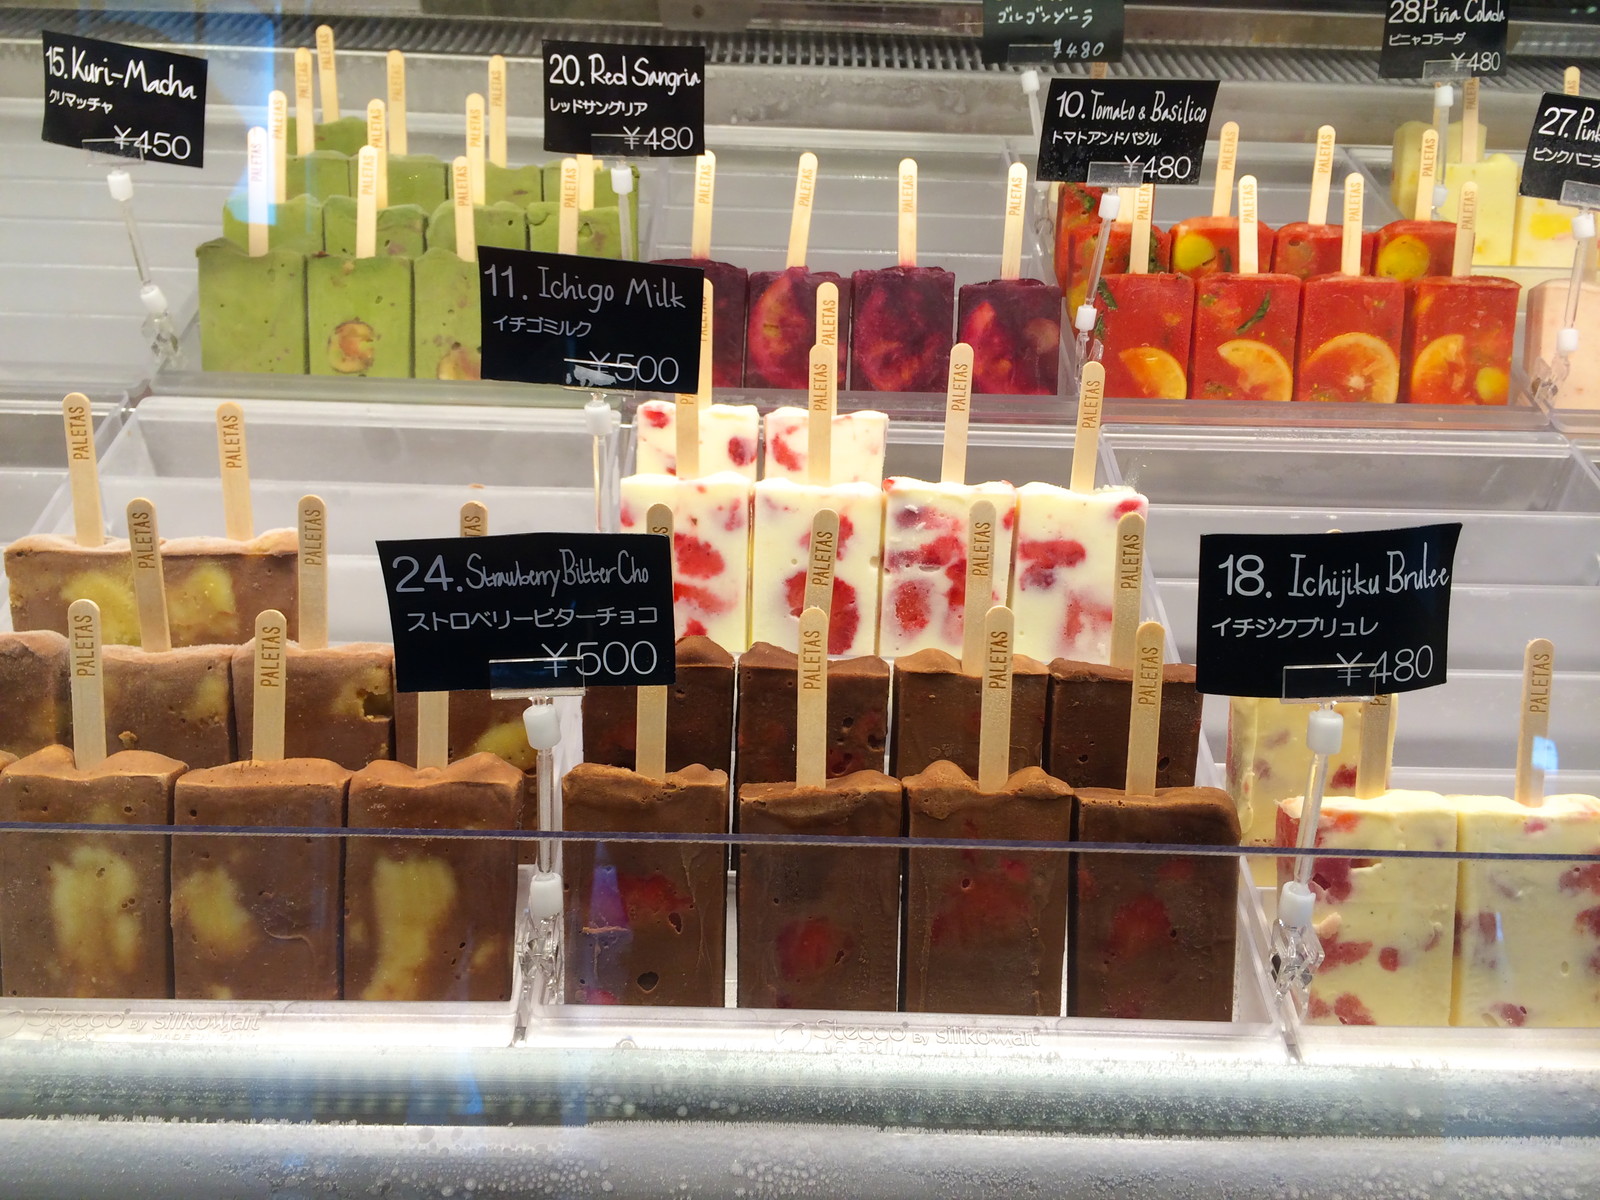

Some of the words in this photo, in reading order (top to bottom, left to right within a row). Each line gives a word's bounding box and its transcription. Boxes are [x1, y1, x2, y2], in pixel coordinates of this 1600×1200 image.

[1423, 0, 1461, 24] Piña
[1464, 0, 1505, 23] Colada
[1053, 38, 1105, 59] ¥480
[1388, 31, 1467, 46] ピニャコラーダ
[588, 53, 628, 87] Red
[631, 55, 701, 95] Sangria
[1450, 51, 1501, 72] ¥480
[49, 90, 113, 116] クリマッチャ
[549, 98, 648, 117] レッドサングリア
[1090, 88, 1136, 121] Tomato
[1149, 90, 1207, 124] Basilico
[113, 125, 191, 161] ¥450
[469, 108, 481, 148] PALETAS
[623, 126, 694, 151] ¥480
[1052, 130, 1162, 147] トマトアンドバジル
[251, 141, 265, 183] PALETAS
[1124, 154, 1192, 179] ¥480
[1221, 131, 1236, 172] PALETAS
[1317, 133, 1332, 174] PALETAS
[1421, 137, 1436, 177] PALETAS
[362, 154, 375, 196] PALETAS
[455, 165, 470, 207] PALETAS
[564, 167, 577, 209] PALETAS
[697, 163, 713, 205] PALETAS
[798, 168, 814, 208] PALETAS
[901, 174, 914, 214] PALETAS
[1008, 176, 1023, 217] PALETAS
[1136, 183, 1151, 221] PALETA
[1243, 183, 1255, 225] PALETAS
[1349, 181, 1362, 222] PALETAS
[1461, 189, 1475, 231] PALETAS
[536, 265, 615, 314] Ichigo
[625, 277, 687, 310] Milk
[492, 314, 593, 338] イチゴミルク
[822, 298, 836, 346] PALETAS
[589, 350, 680, 385] ¥500
[813, 362, 828, 412] PALETAS
[951, 362, 969, 412] PALETAS
[1081, 379, 1101, 429] PALETAS
[68, 404, 90, 461] PALETAS
[221, 414, 243, 469] PALETAS
[132, 511, 156, 569] PALETAS
[304, 508, 322, 567] PALETAS
[811, 530, 833, 587] PALETAS
[971, 521, 991, 577] PALETAS
[559, 549, 618, 586] Bitter
[617, 550, 649, 585] Cho
[1120, 533, 1140, 589] PALETAS
[1287, 553, 1380, 609] Ichijiku
[1385, 541, 1450, 594] Brulee
[407, 606, 658, 632] ストロベリービターチョコ
[73, 613, 96, 678] PALETAS
[260, 625, 281, 688] PALETAS
[541, 640, 658, 678] ¥500
[803, 629, 821, 690] PALETAS
[988, 630, 1009, 690] PALETAS
[1336, 644, 1434, 687] ¥480
[1137, 646, 1159, 706] PALETAS
[1528, 652, 1550, 714] PALETAS
